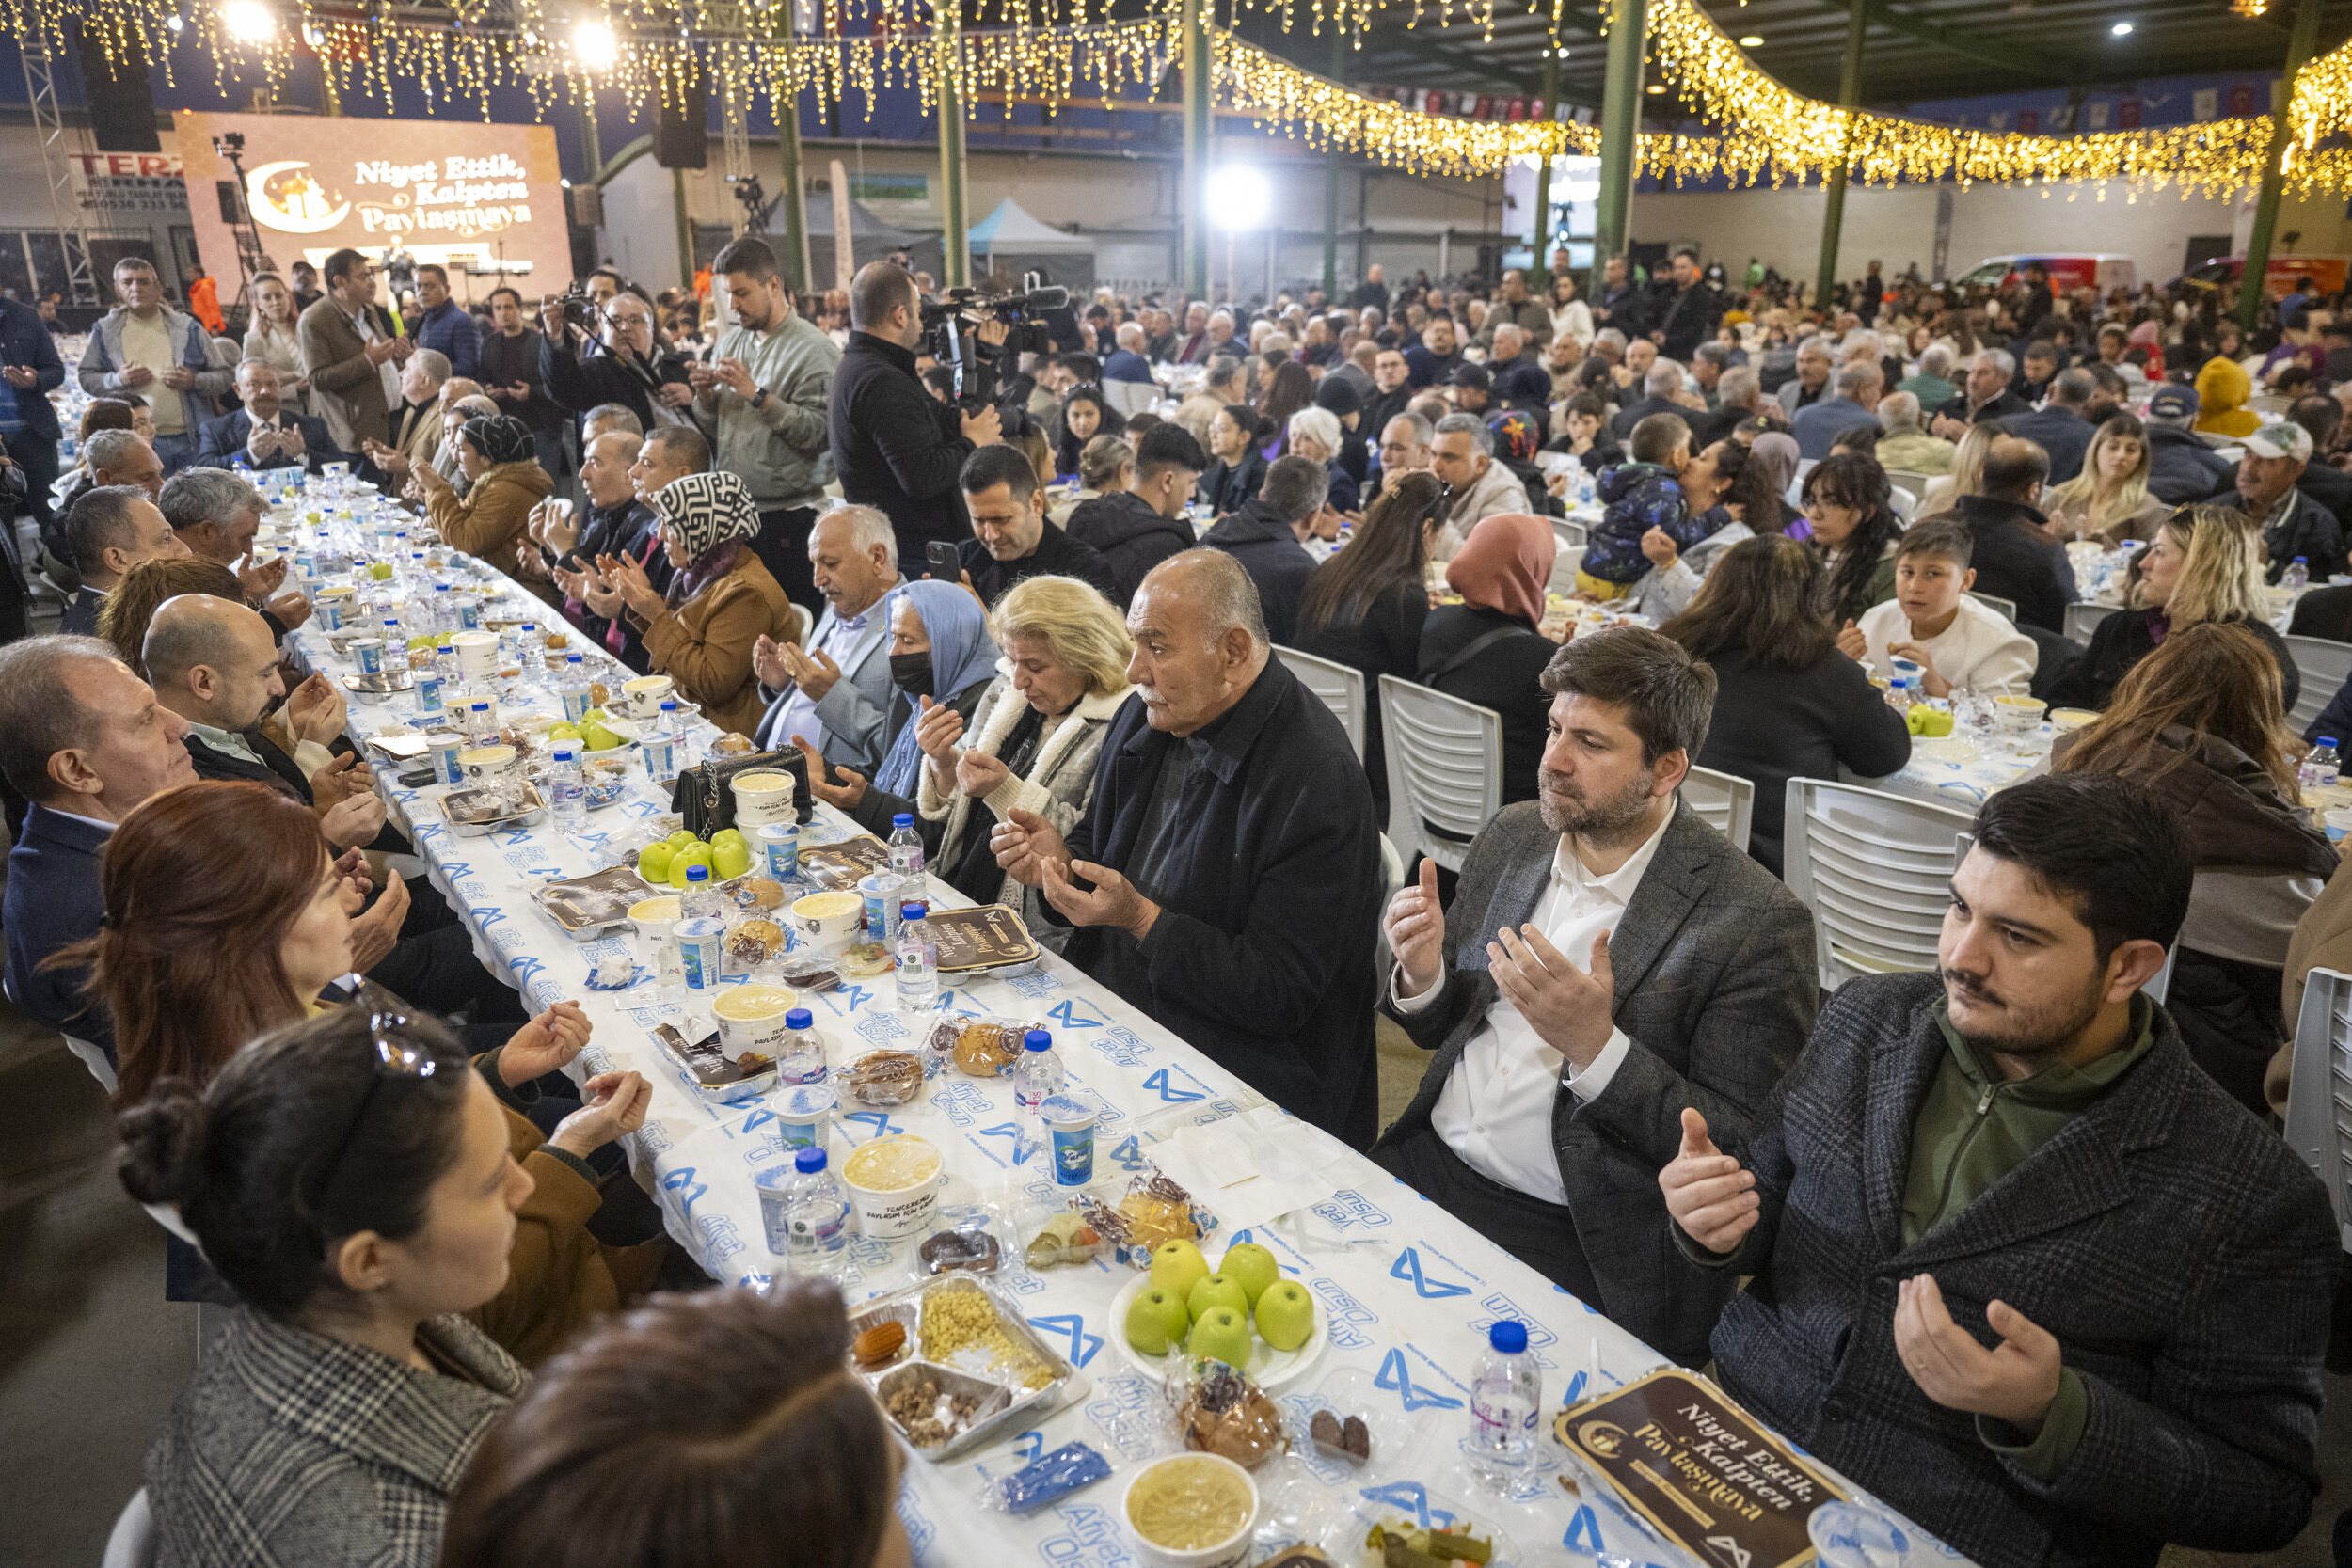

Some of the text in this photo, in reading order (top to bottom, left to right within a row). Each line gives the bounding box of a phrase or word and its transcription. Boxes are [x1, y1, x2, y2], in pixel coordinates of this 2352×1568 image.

[355, 153, 526, 188] Niyet Ettik,
[415, 180, 529, 207] Kalpten
[357, 203, 532, 237] Paylaşmaya
[948, 1081, 991, 1113] Afiyet
[1313, 1279, 1375, 1323] Olsun
[1633, 1422, 1765, 1522] Paylaşmaya
[1677, 1403, 1749, 1451] Niyet
[1744, 1449, 1813, 1503] Ettik,
[1694, 1439, 1793, 1511] Kalpten
